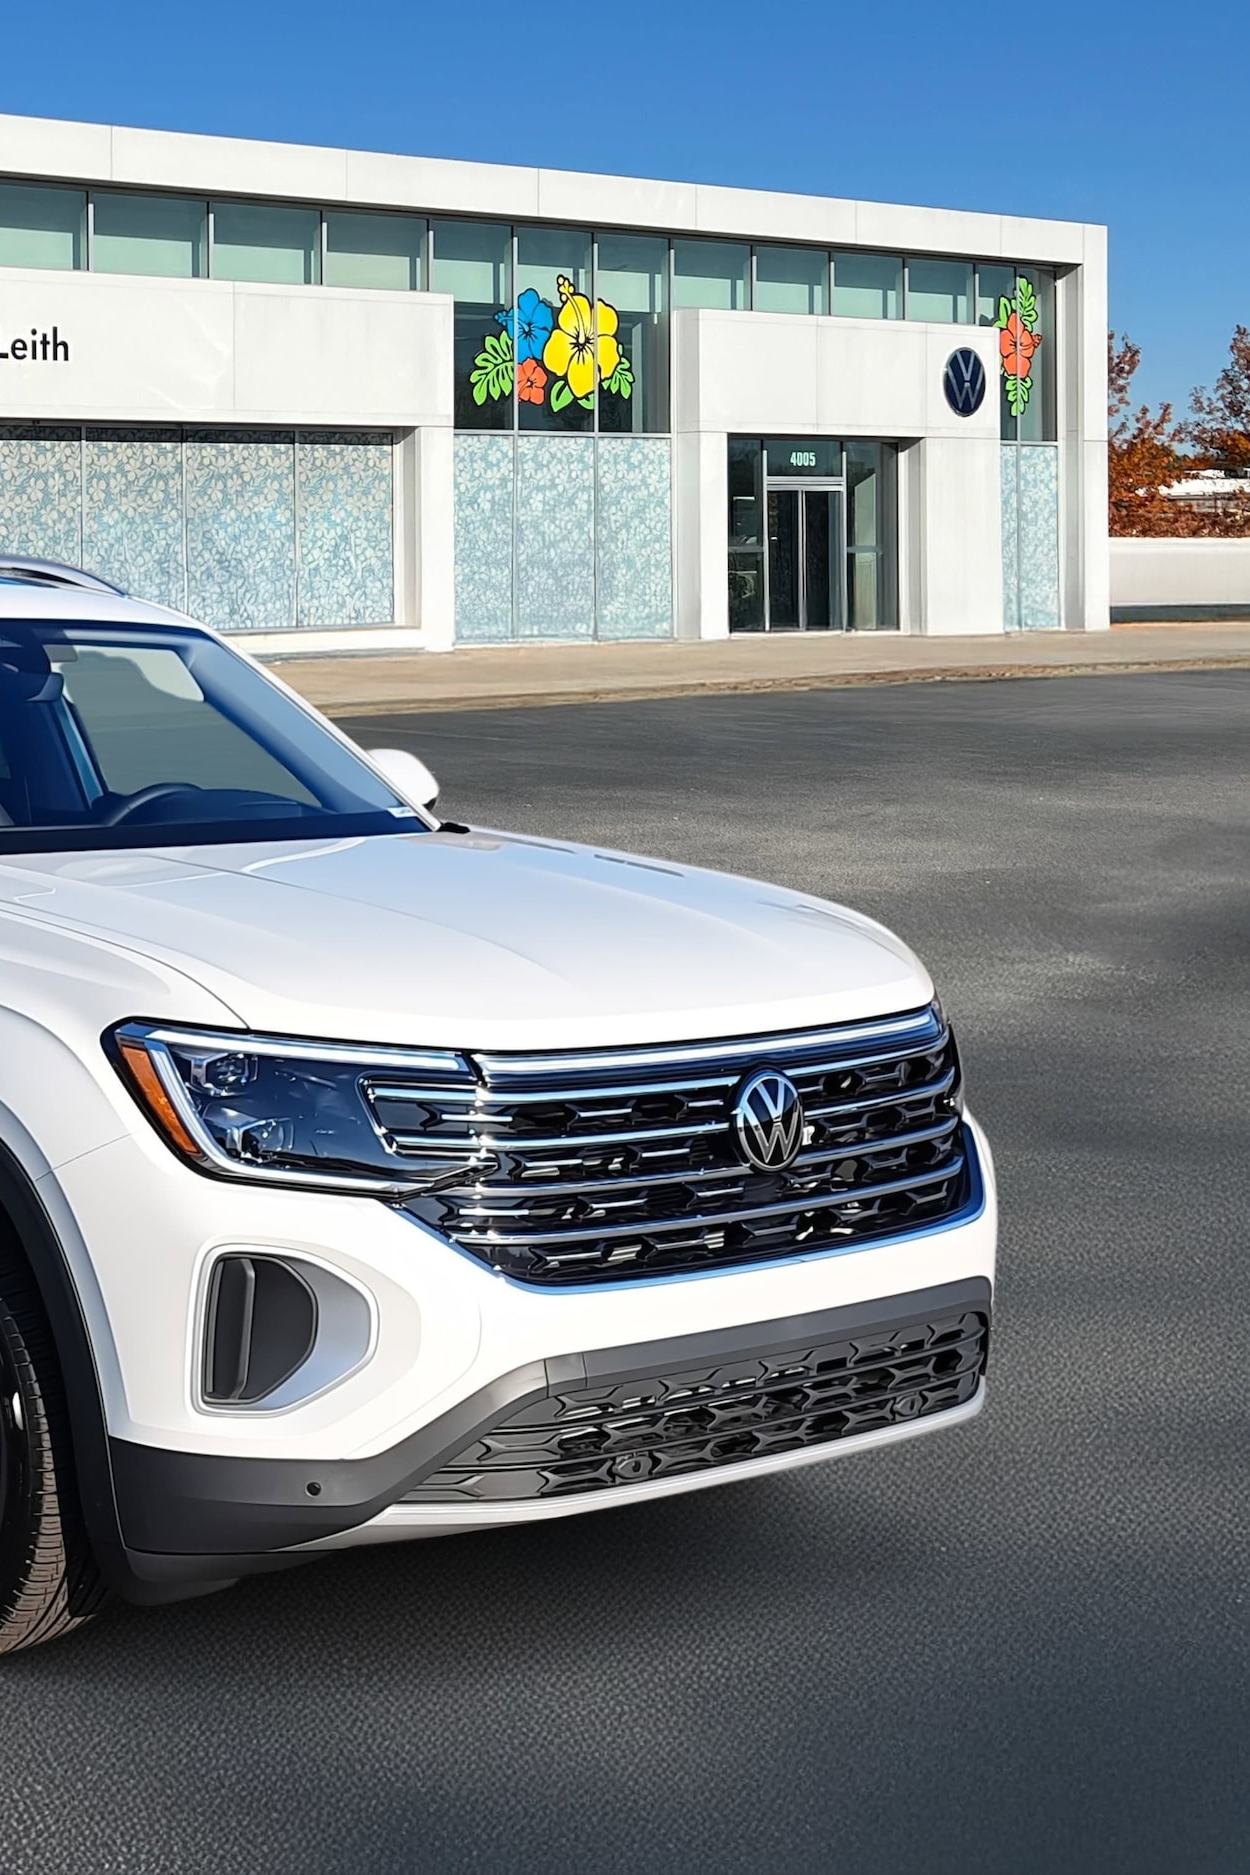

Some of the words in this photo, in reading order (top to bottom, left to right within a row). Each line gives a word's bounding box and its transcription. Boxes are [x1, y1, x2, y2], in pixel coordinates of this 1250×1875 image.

[944, 347, 985, 416] VW
[790, 451, 816, 466] 4005
[737, 1072, 802, 1171] VW
